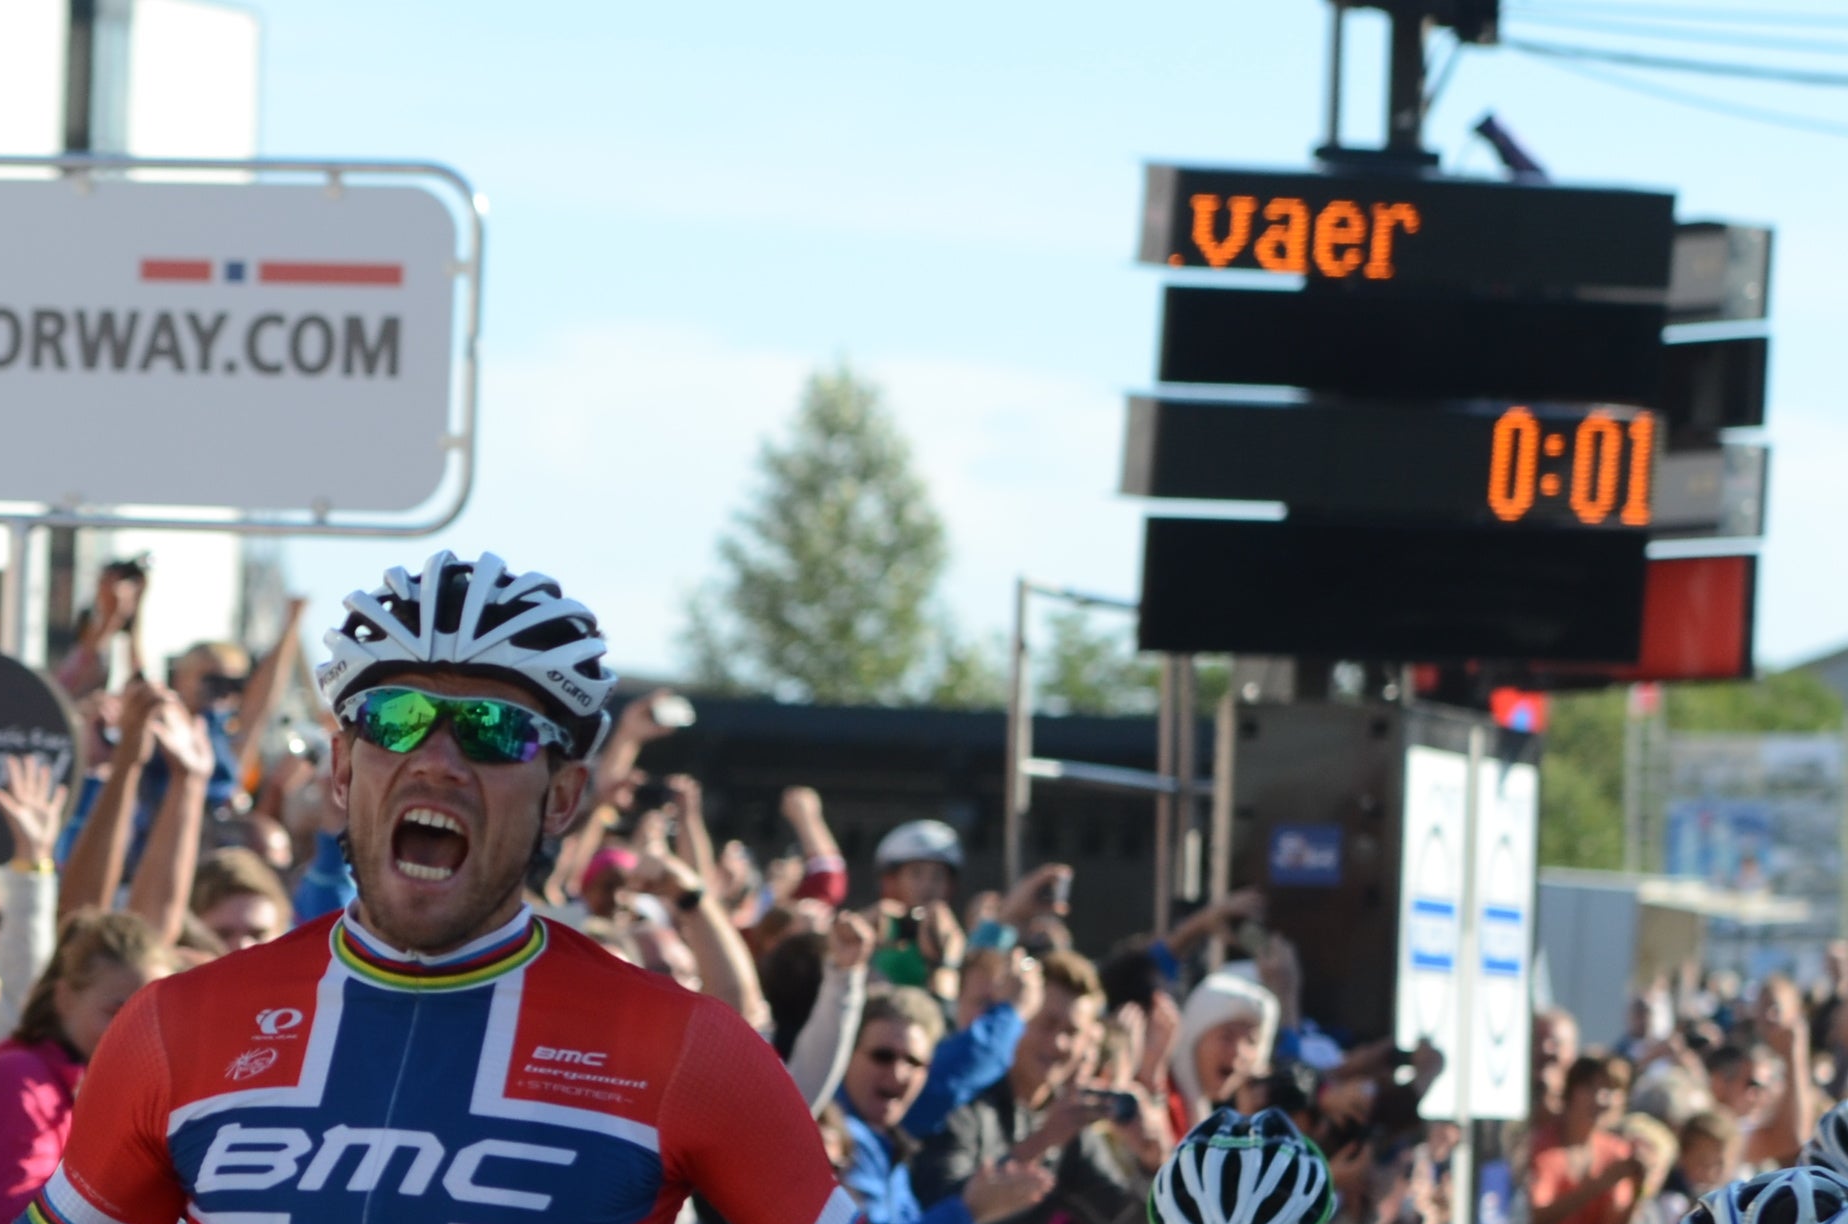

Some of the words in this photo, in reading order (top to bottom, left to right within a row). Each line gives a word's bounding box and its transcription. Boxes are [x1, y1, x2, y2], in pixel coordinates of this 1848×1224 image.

[1487, 406, 1652, 526] 0:01
[560, 676, 594, 709] GIRO
[532, 1045, 608, 1067] BMC
[524, 1063, 649, 1090] bergamont
[194, 1121, 578, 1211] BMC
